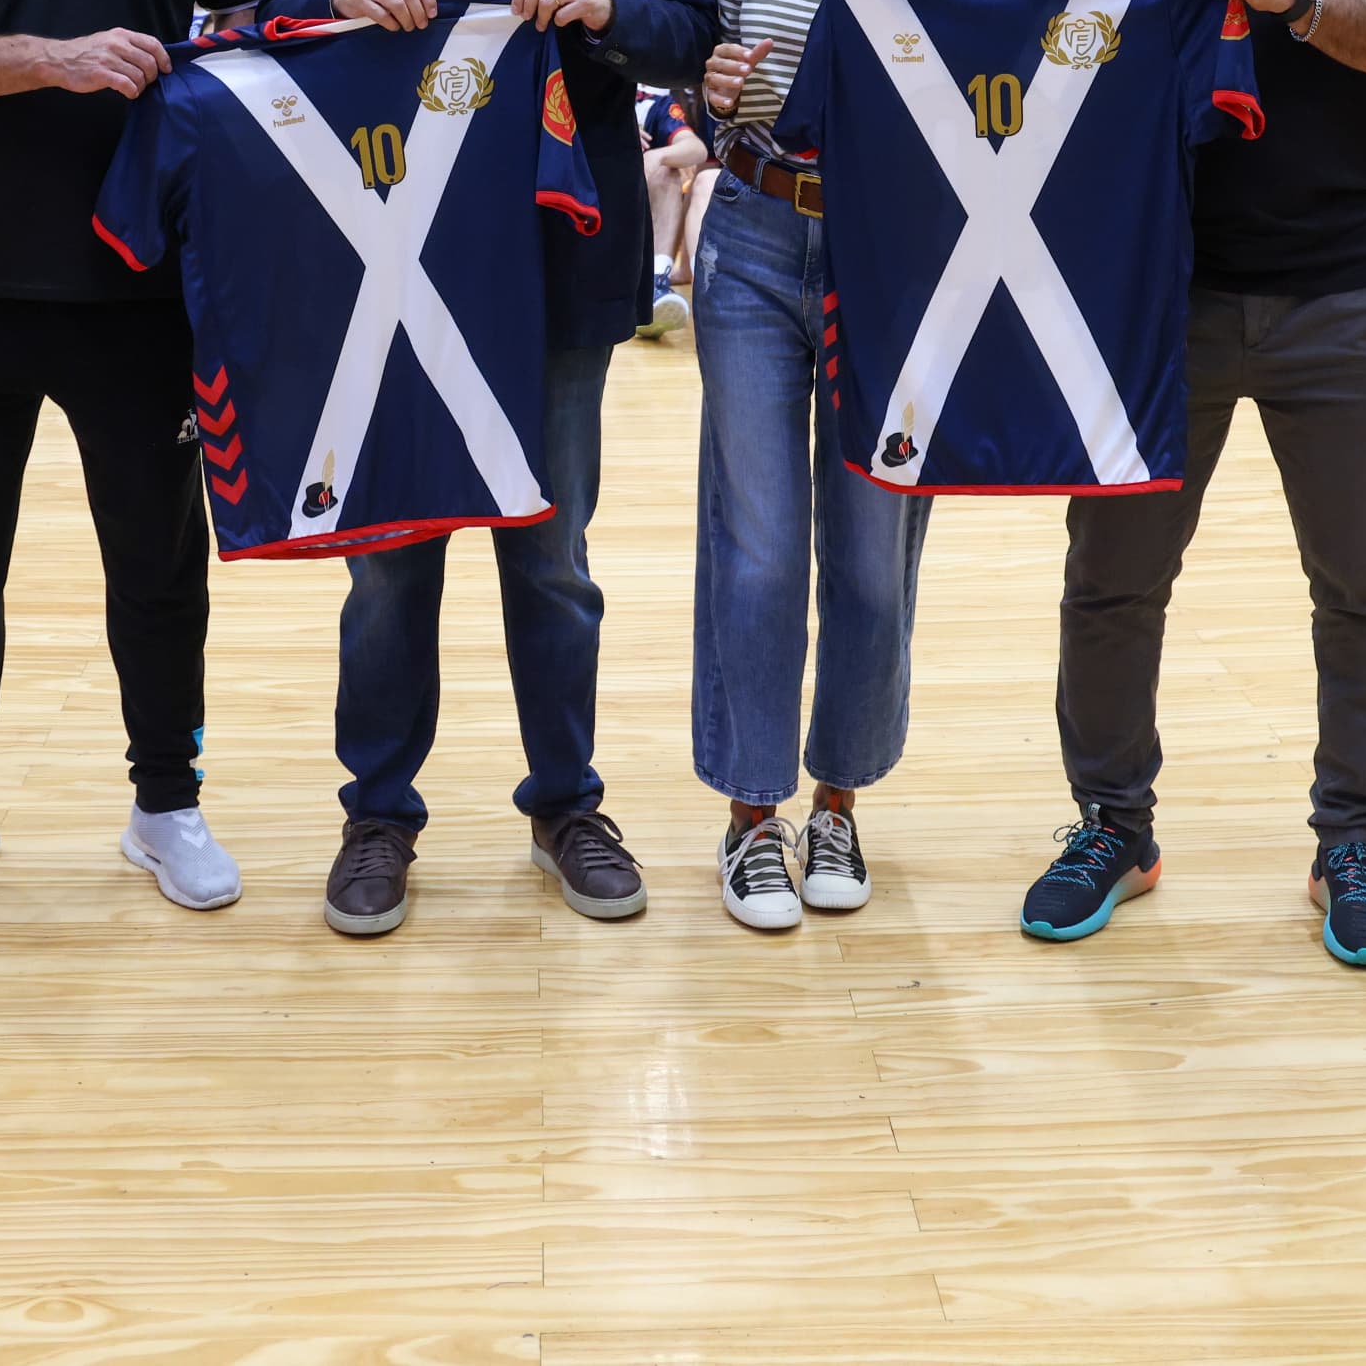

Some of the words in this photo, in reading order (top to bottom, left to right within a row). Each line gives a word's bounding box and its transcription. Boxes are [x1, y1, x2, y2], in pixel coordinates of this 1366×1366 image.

[891, 52, 925, 64] hummel
[273, 114, 306, 128] hummel
[967, 73, 1024, 139] 10
[350, 123, 407, 190] 10
